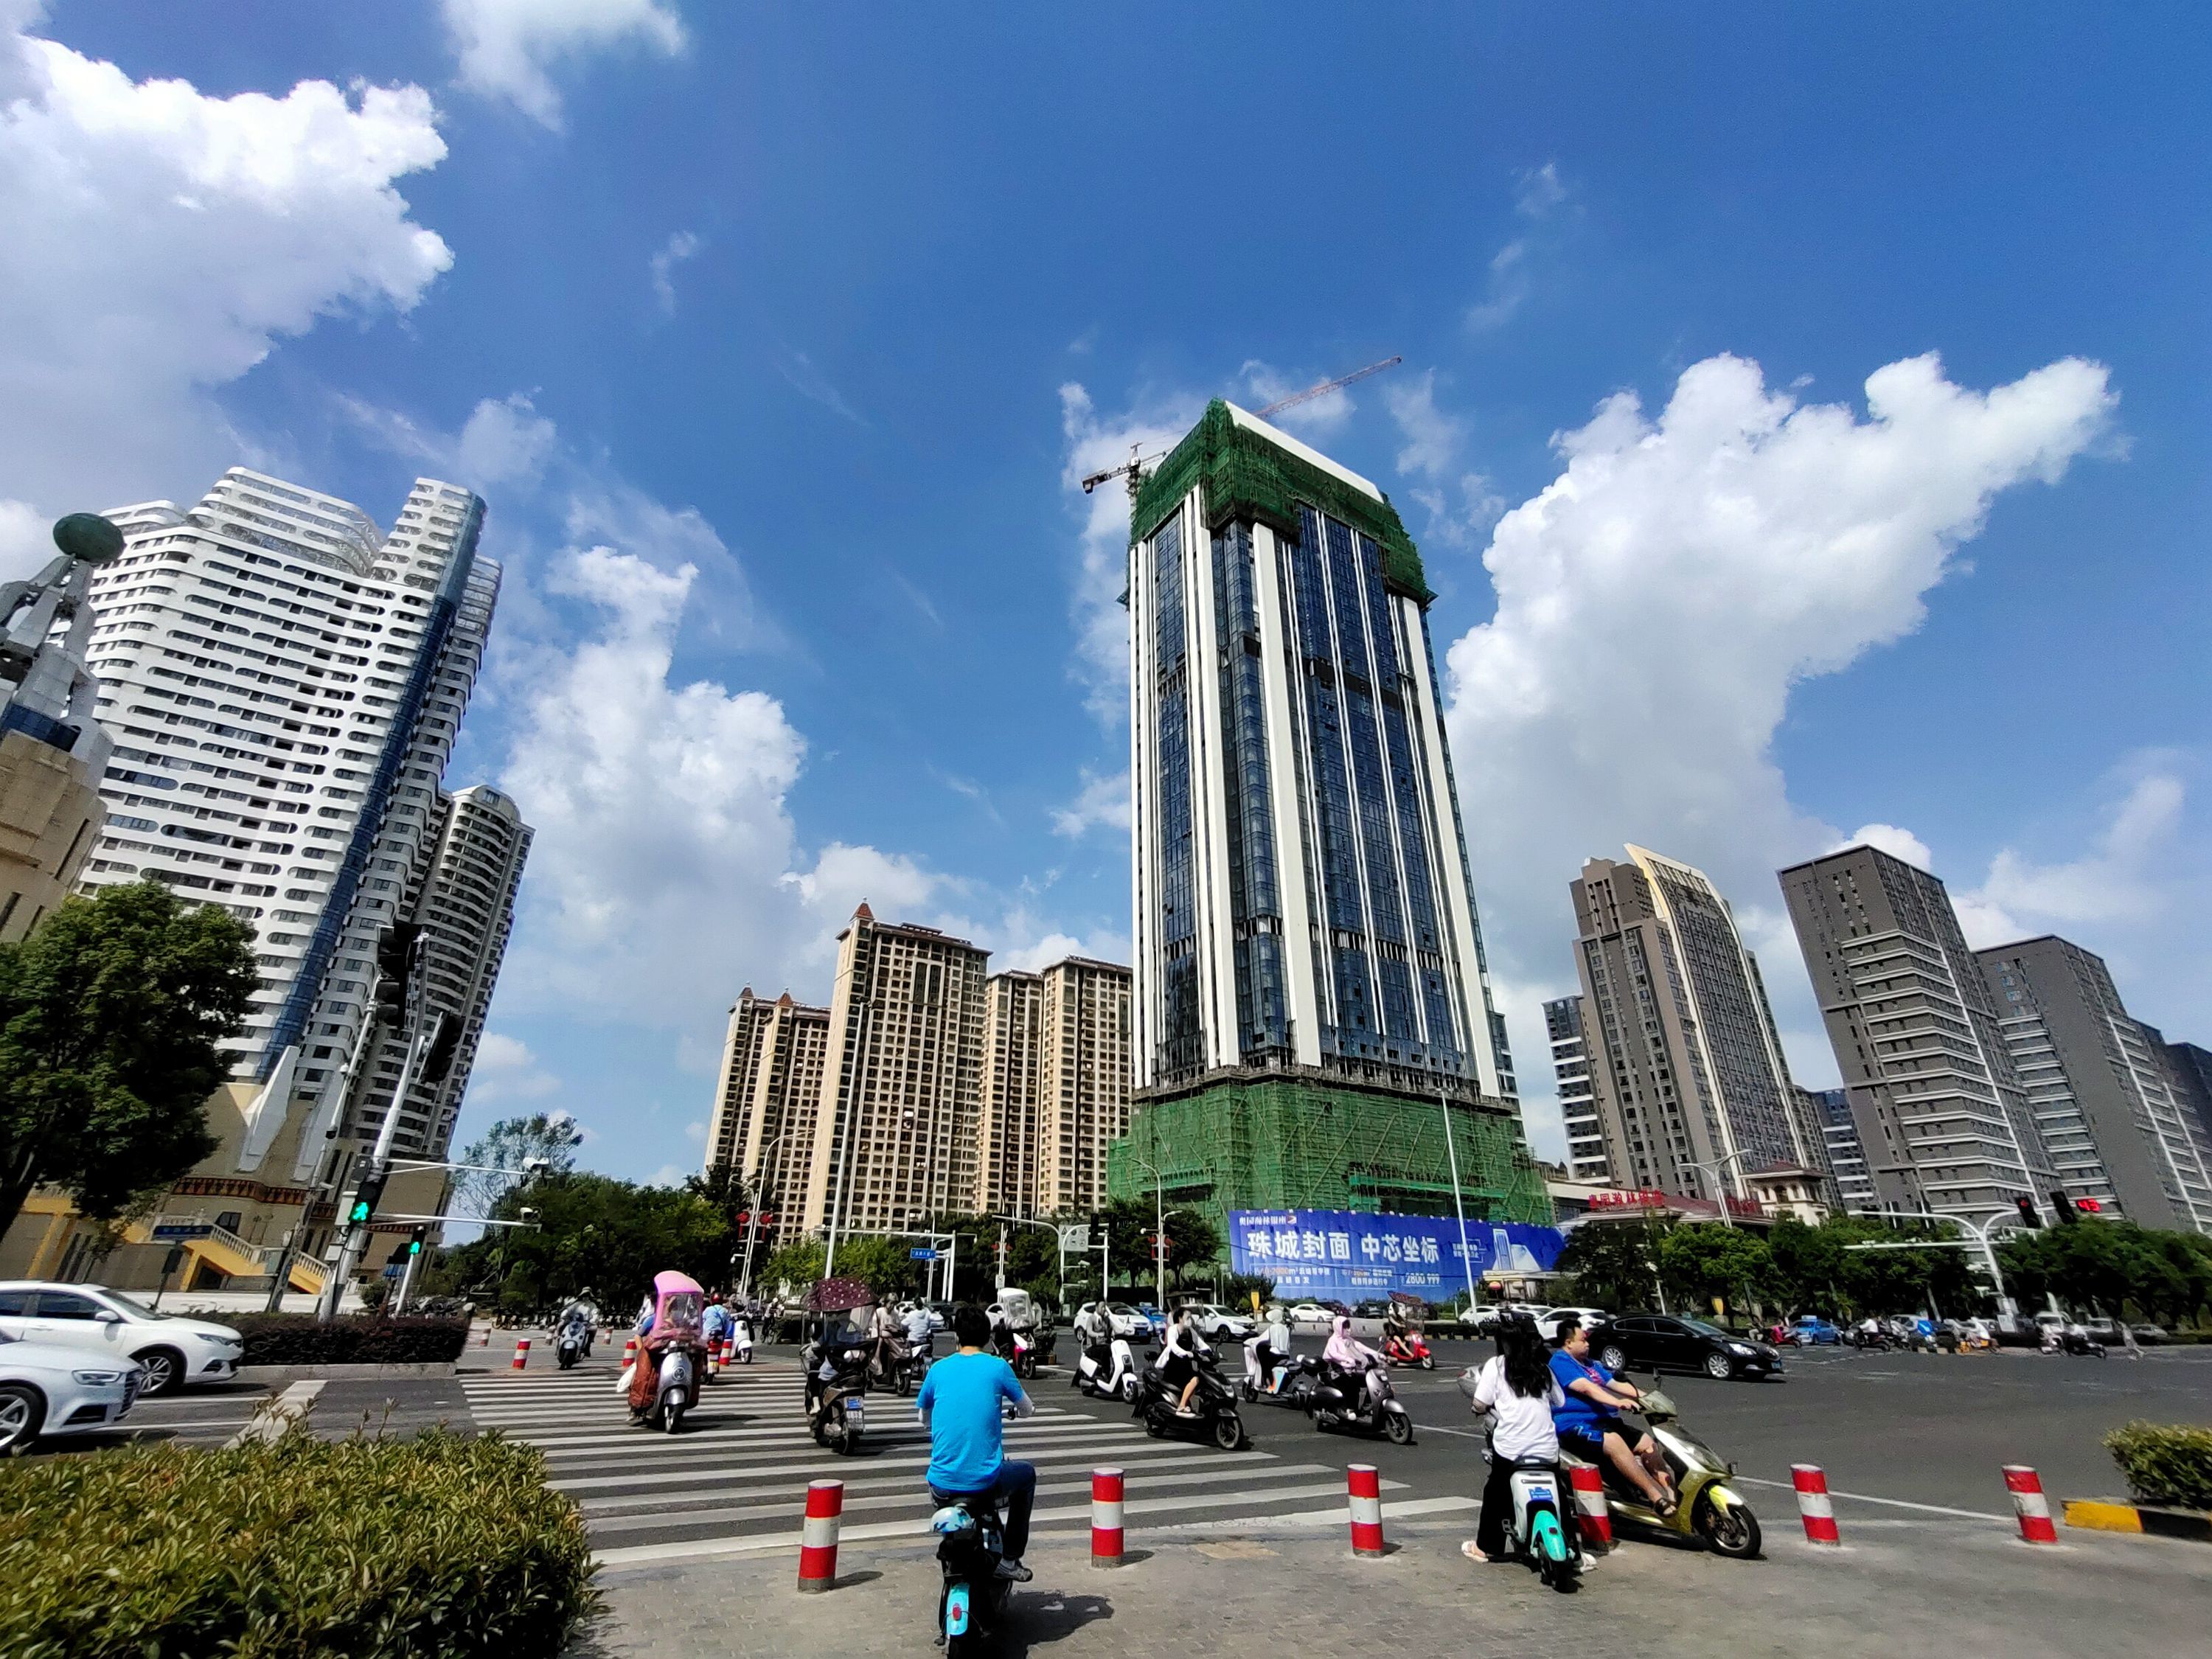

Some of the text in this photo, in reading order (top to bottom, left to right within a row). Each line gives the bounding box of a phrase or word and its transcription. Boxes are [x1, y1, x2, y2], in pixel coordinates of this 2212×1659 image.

[1247, 1229, 1440, 1264] 珠城封面 中芯坐标
